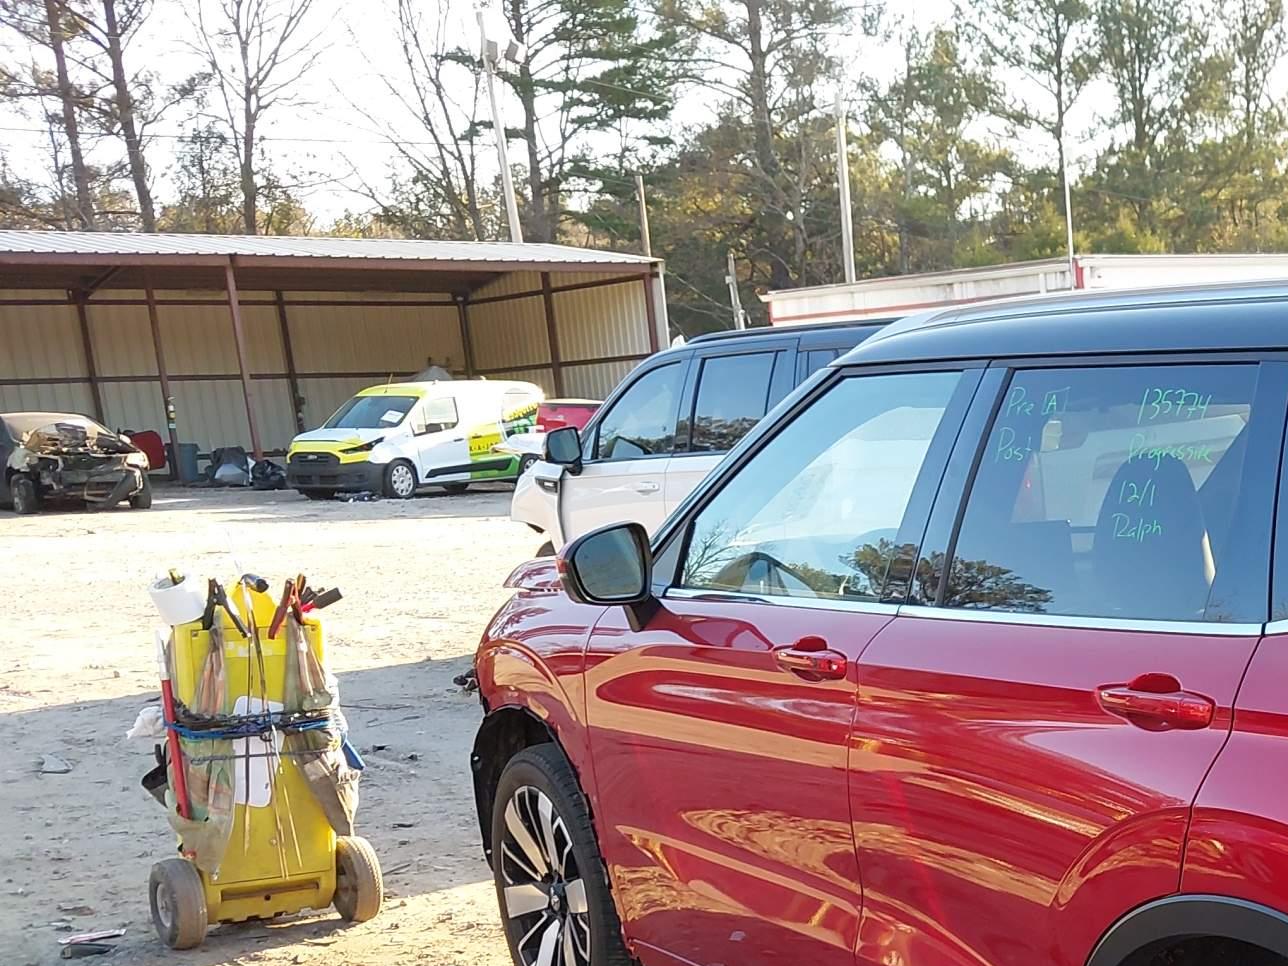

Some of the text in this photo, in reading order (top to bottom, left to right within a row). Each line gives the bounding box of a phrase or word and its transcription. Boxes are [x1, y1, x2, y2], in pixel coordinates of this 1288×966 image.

[1006, 386, 1035, 417] Pre
[1137, 387, 1212, 425] 135774
[995, 426, 1033, 464] Post
[1118, 479, 1156, 506] 12/1
[1111, 512, 1162, 542] Ralph
